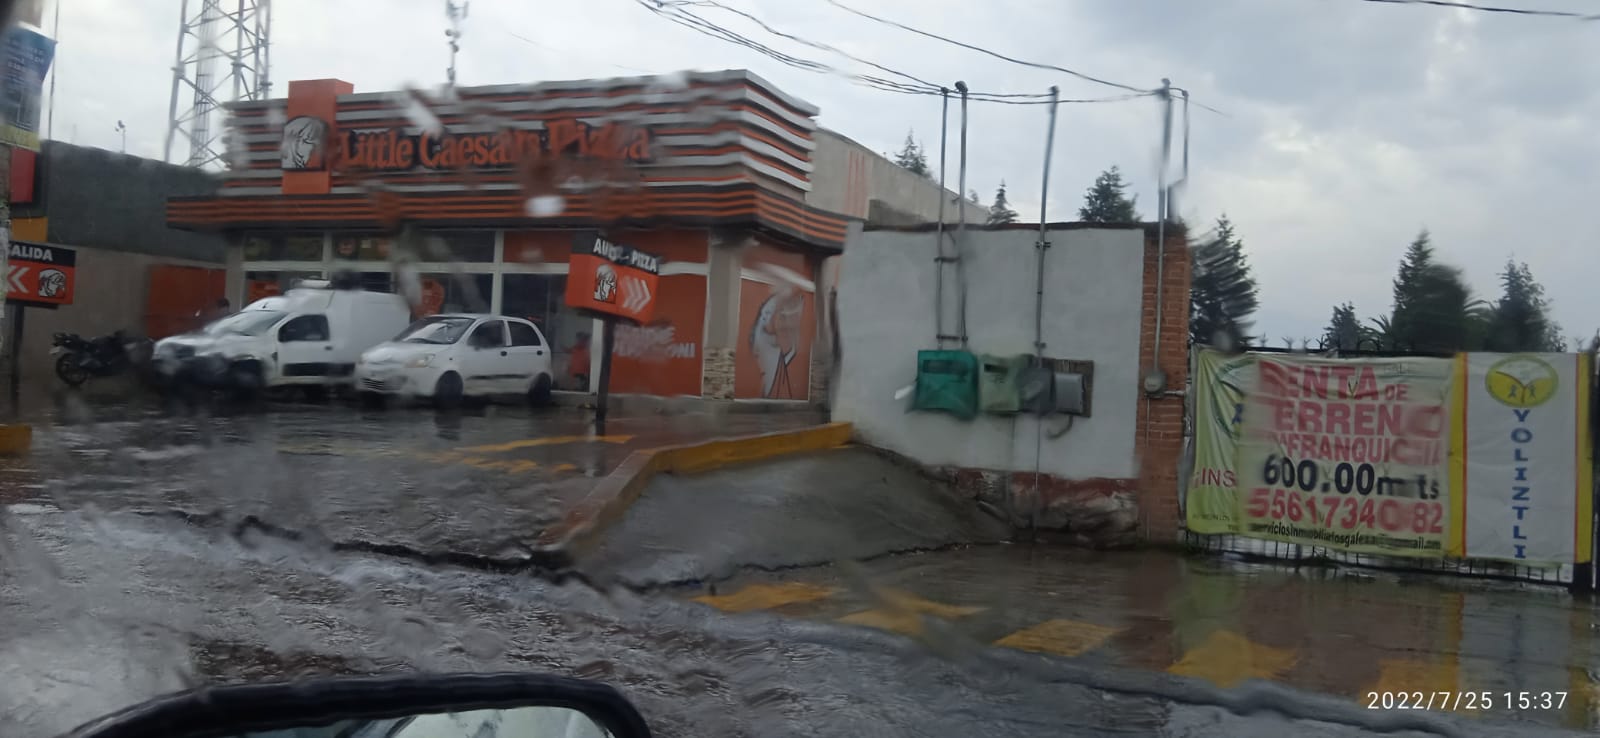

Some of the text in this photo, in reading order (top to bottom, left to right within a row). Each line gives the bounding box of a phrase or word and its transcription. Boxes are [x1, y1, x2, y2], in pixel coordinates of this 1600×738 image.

[338, 128, 413, 168] Little
[8, 244, 54, 262] ALIDA
[1384, 384, 1408, 400] DE
[1511, 409, 1533, 558] YOLIZTLI
